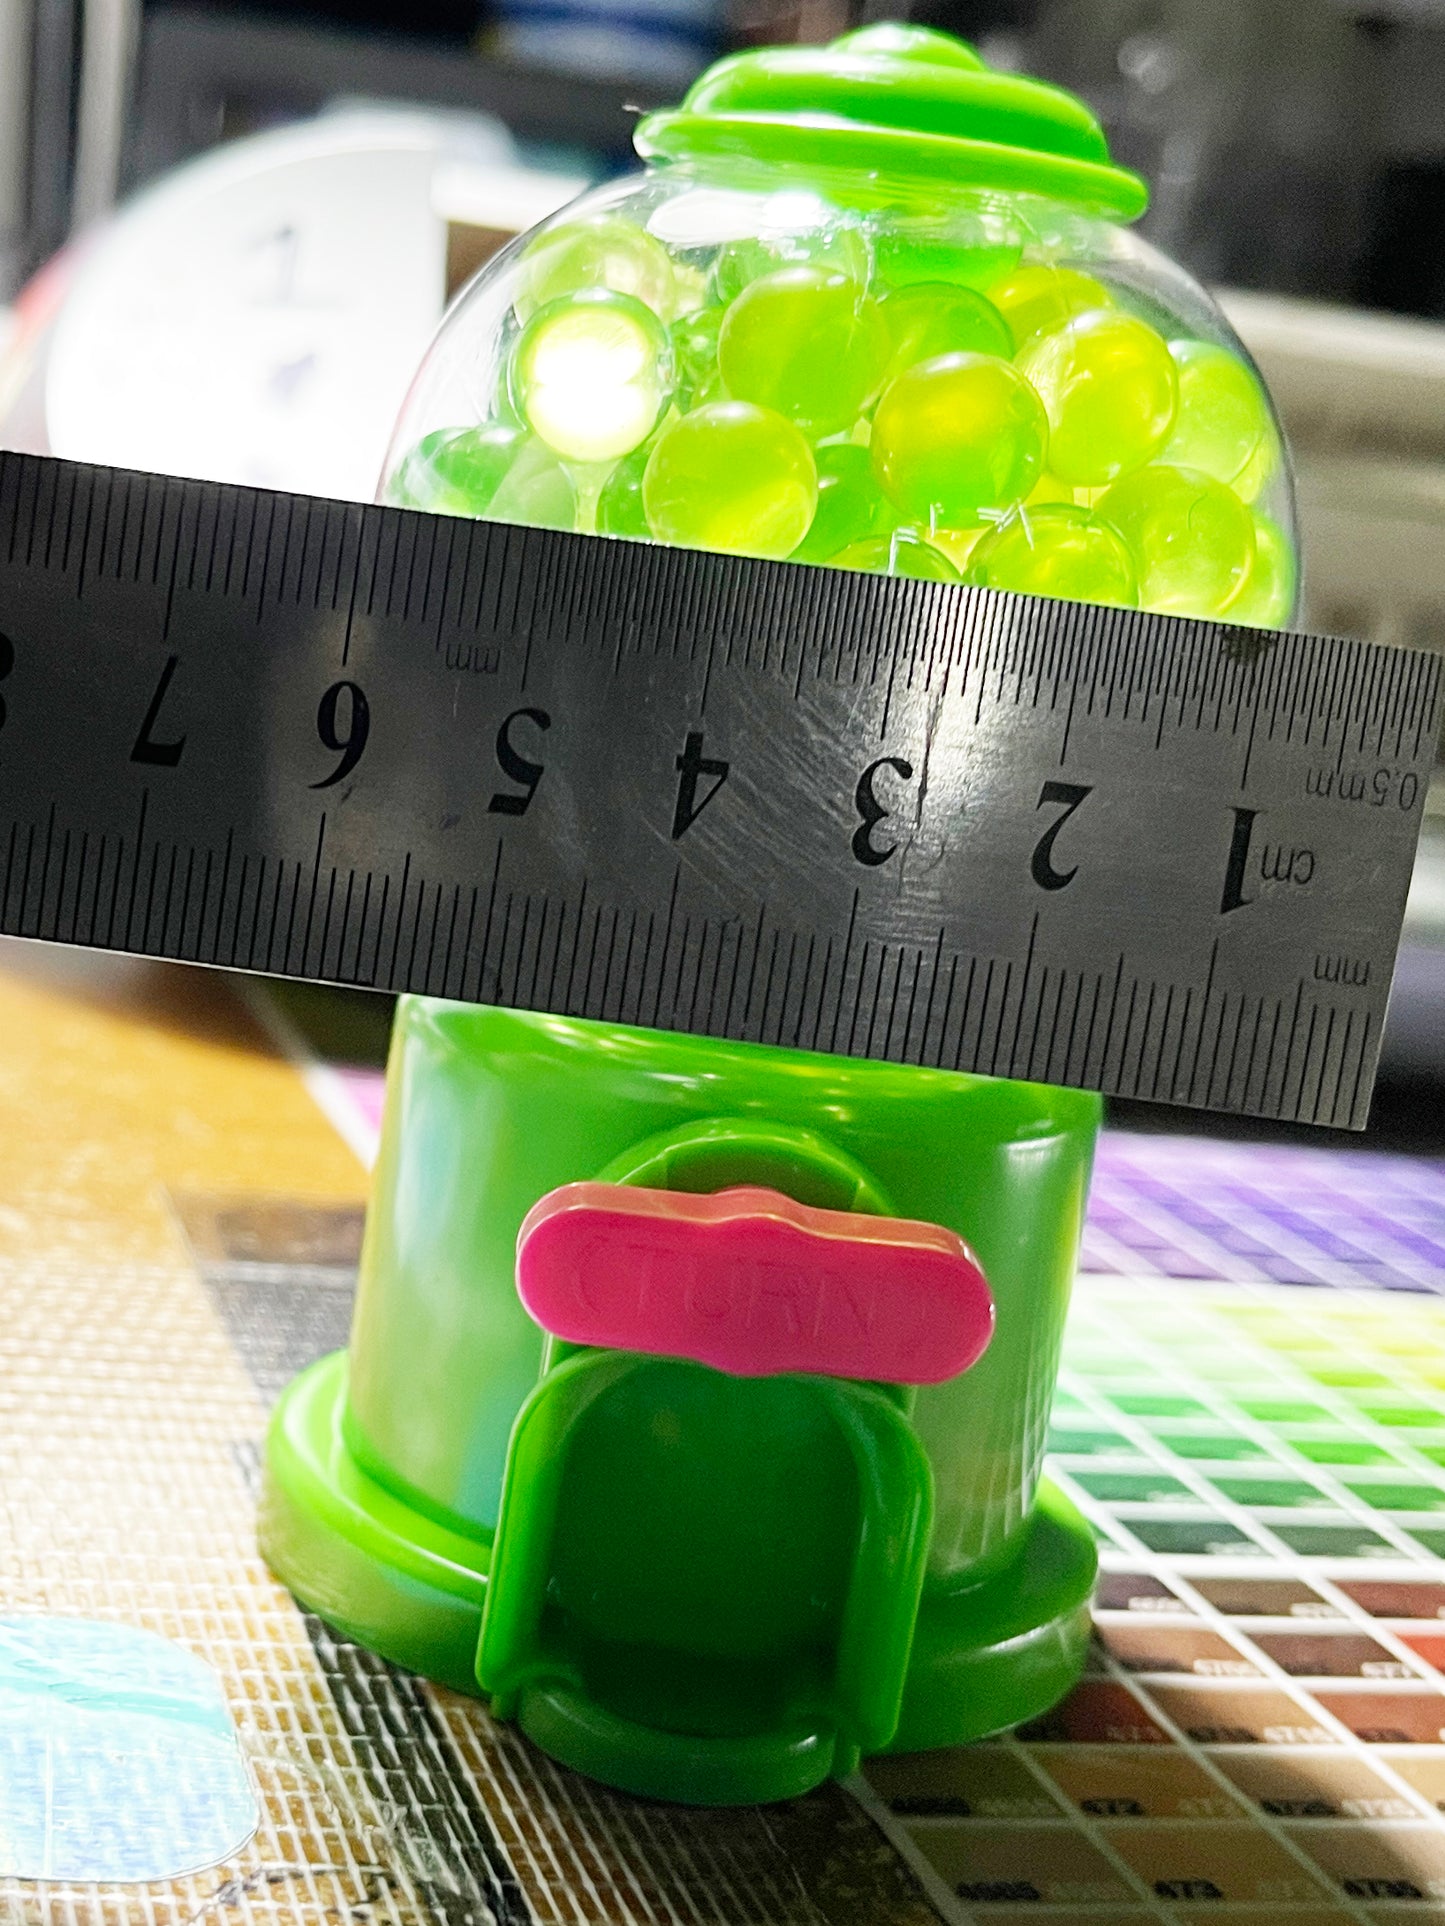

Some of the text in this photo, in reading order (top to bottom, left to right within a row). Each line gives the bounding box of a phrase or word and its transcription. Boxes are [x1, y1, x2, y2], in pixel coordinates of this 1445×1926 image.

[129, 655, 187, 768] 7
[445, 643, 500, 675] mm
[487, 707, 552, 817] 5
[672, 731, 732, 840] 4
[851, 757, 913, 867] 3
[1030, 781, 1094, 891] 2
[1219, 806, 1264, 915] 1
[1260, 845, 1316, 886] cm
[1313, 954, 1370, 987] mm
[624, 1240, 880, 1344] TURN
